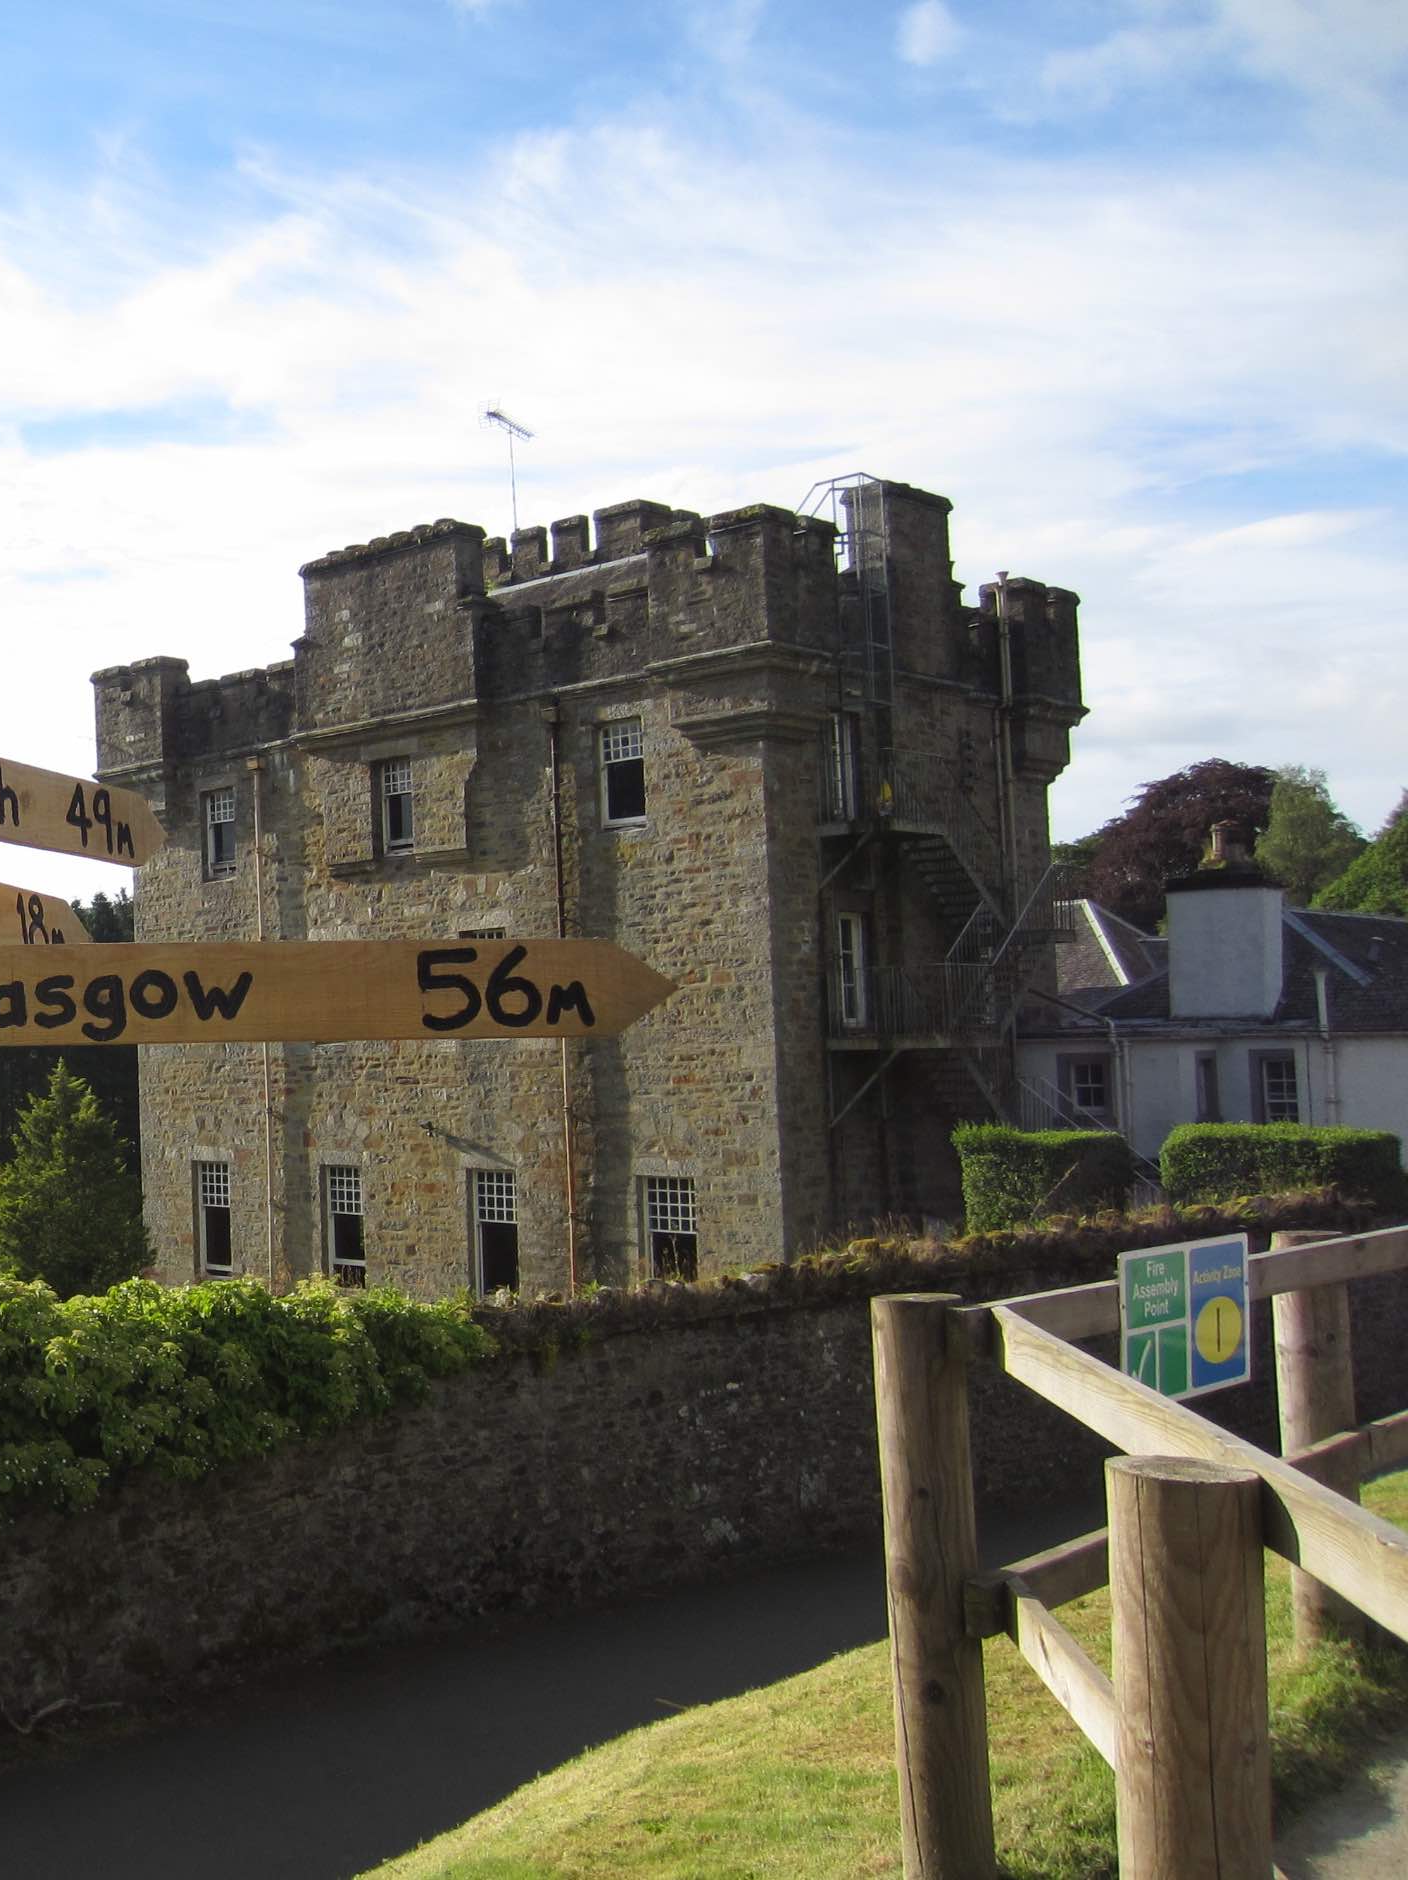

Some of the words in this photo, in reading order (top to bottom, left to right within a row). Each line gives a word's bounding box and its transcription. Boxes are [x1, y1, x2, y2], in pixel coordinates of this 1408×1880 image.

[1146, 1260, 1167, 1278] Fire
[1132, 1276, 1178, 1301] Assembly
[1144, 1299, 1169, 1318] Point
